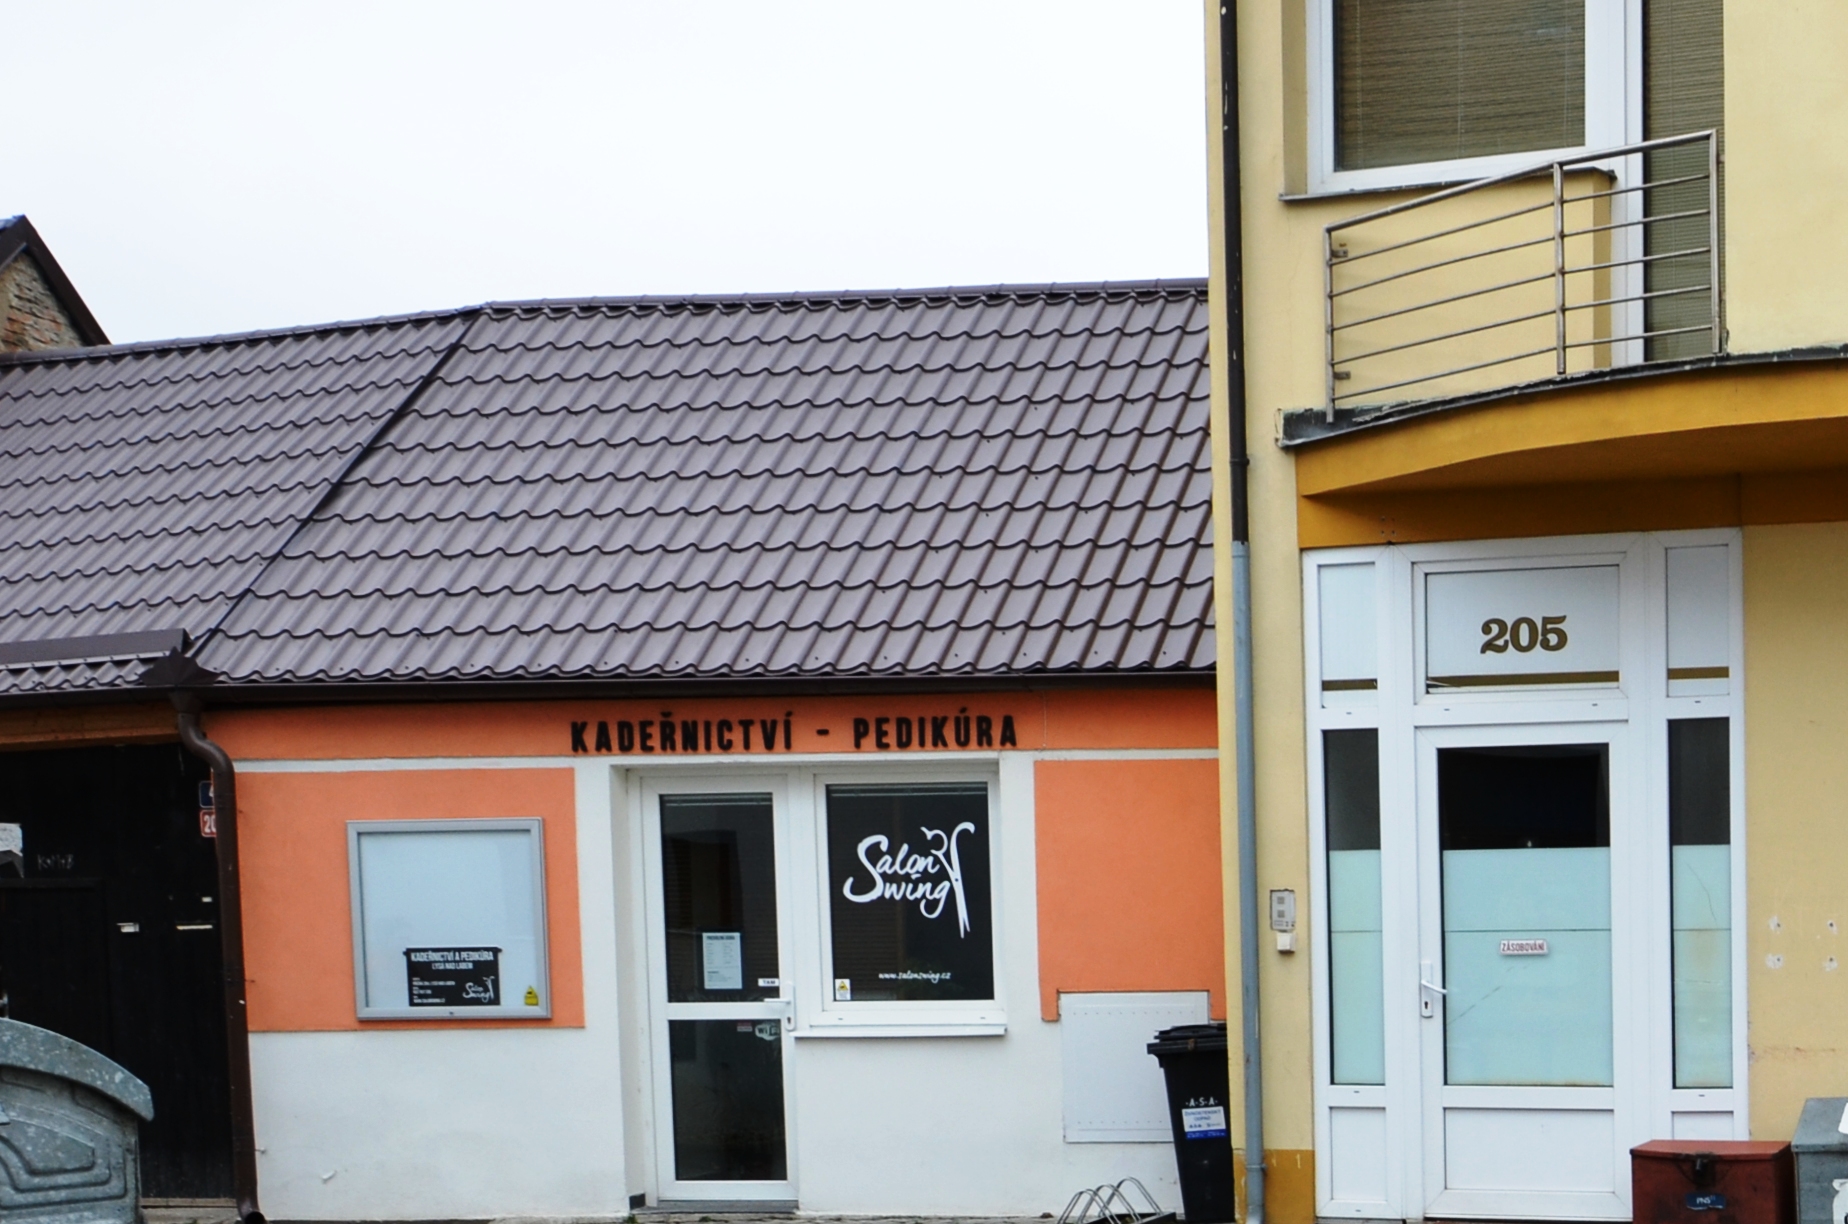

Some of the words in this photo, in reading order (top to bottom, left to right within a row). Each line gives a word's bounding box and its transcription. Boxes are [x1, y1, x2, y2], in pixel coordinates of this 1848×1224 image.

[1480, 615, 1568, 654] 205
[570, 710, 794, 752] KADEŘNICTVÍ
[853, 707, 1018, 749] PEDIKÚRA
[848, 834, 941, 886] Salon
[1501, 940, 1545, 952] ZÁSOBOVÁNÍ
[878, 970, 952, 984] www.salonswing.cz
